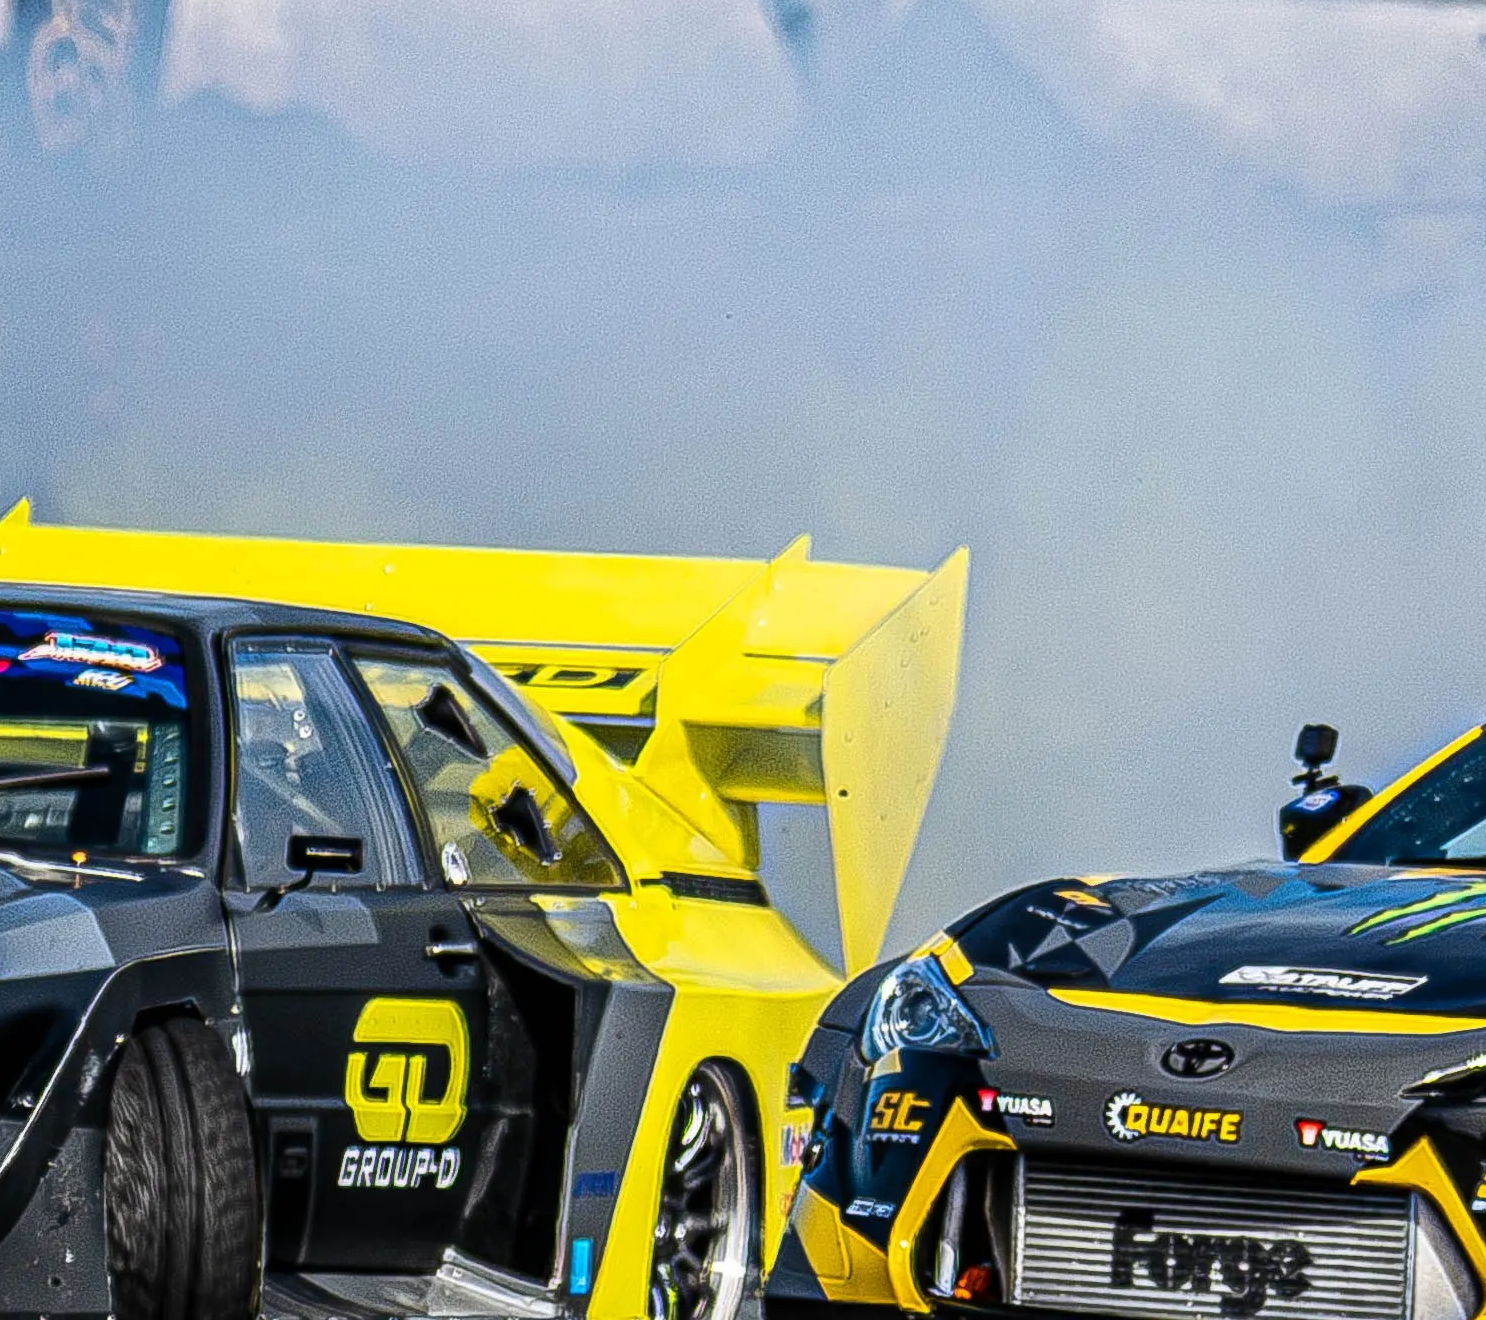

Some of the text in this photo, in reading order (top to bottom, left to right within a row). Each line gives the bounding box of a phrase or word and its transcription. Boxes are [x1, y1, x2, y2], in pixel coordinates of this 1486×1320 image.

[997, 1096, 1053, 1118] YUASA
[1124, 1103, 1242, 1141] QUAIFE
[1321, 1130, 1391, 1154] YUASA
[336, 1145, 462, 1190] GROUP-D
